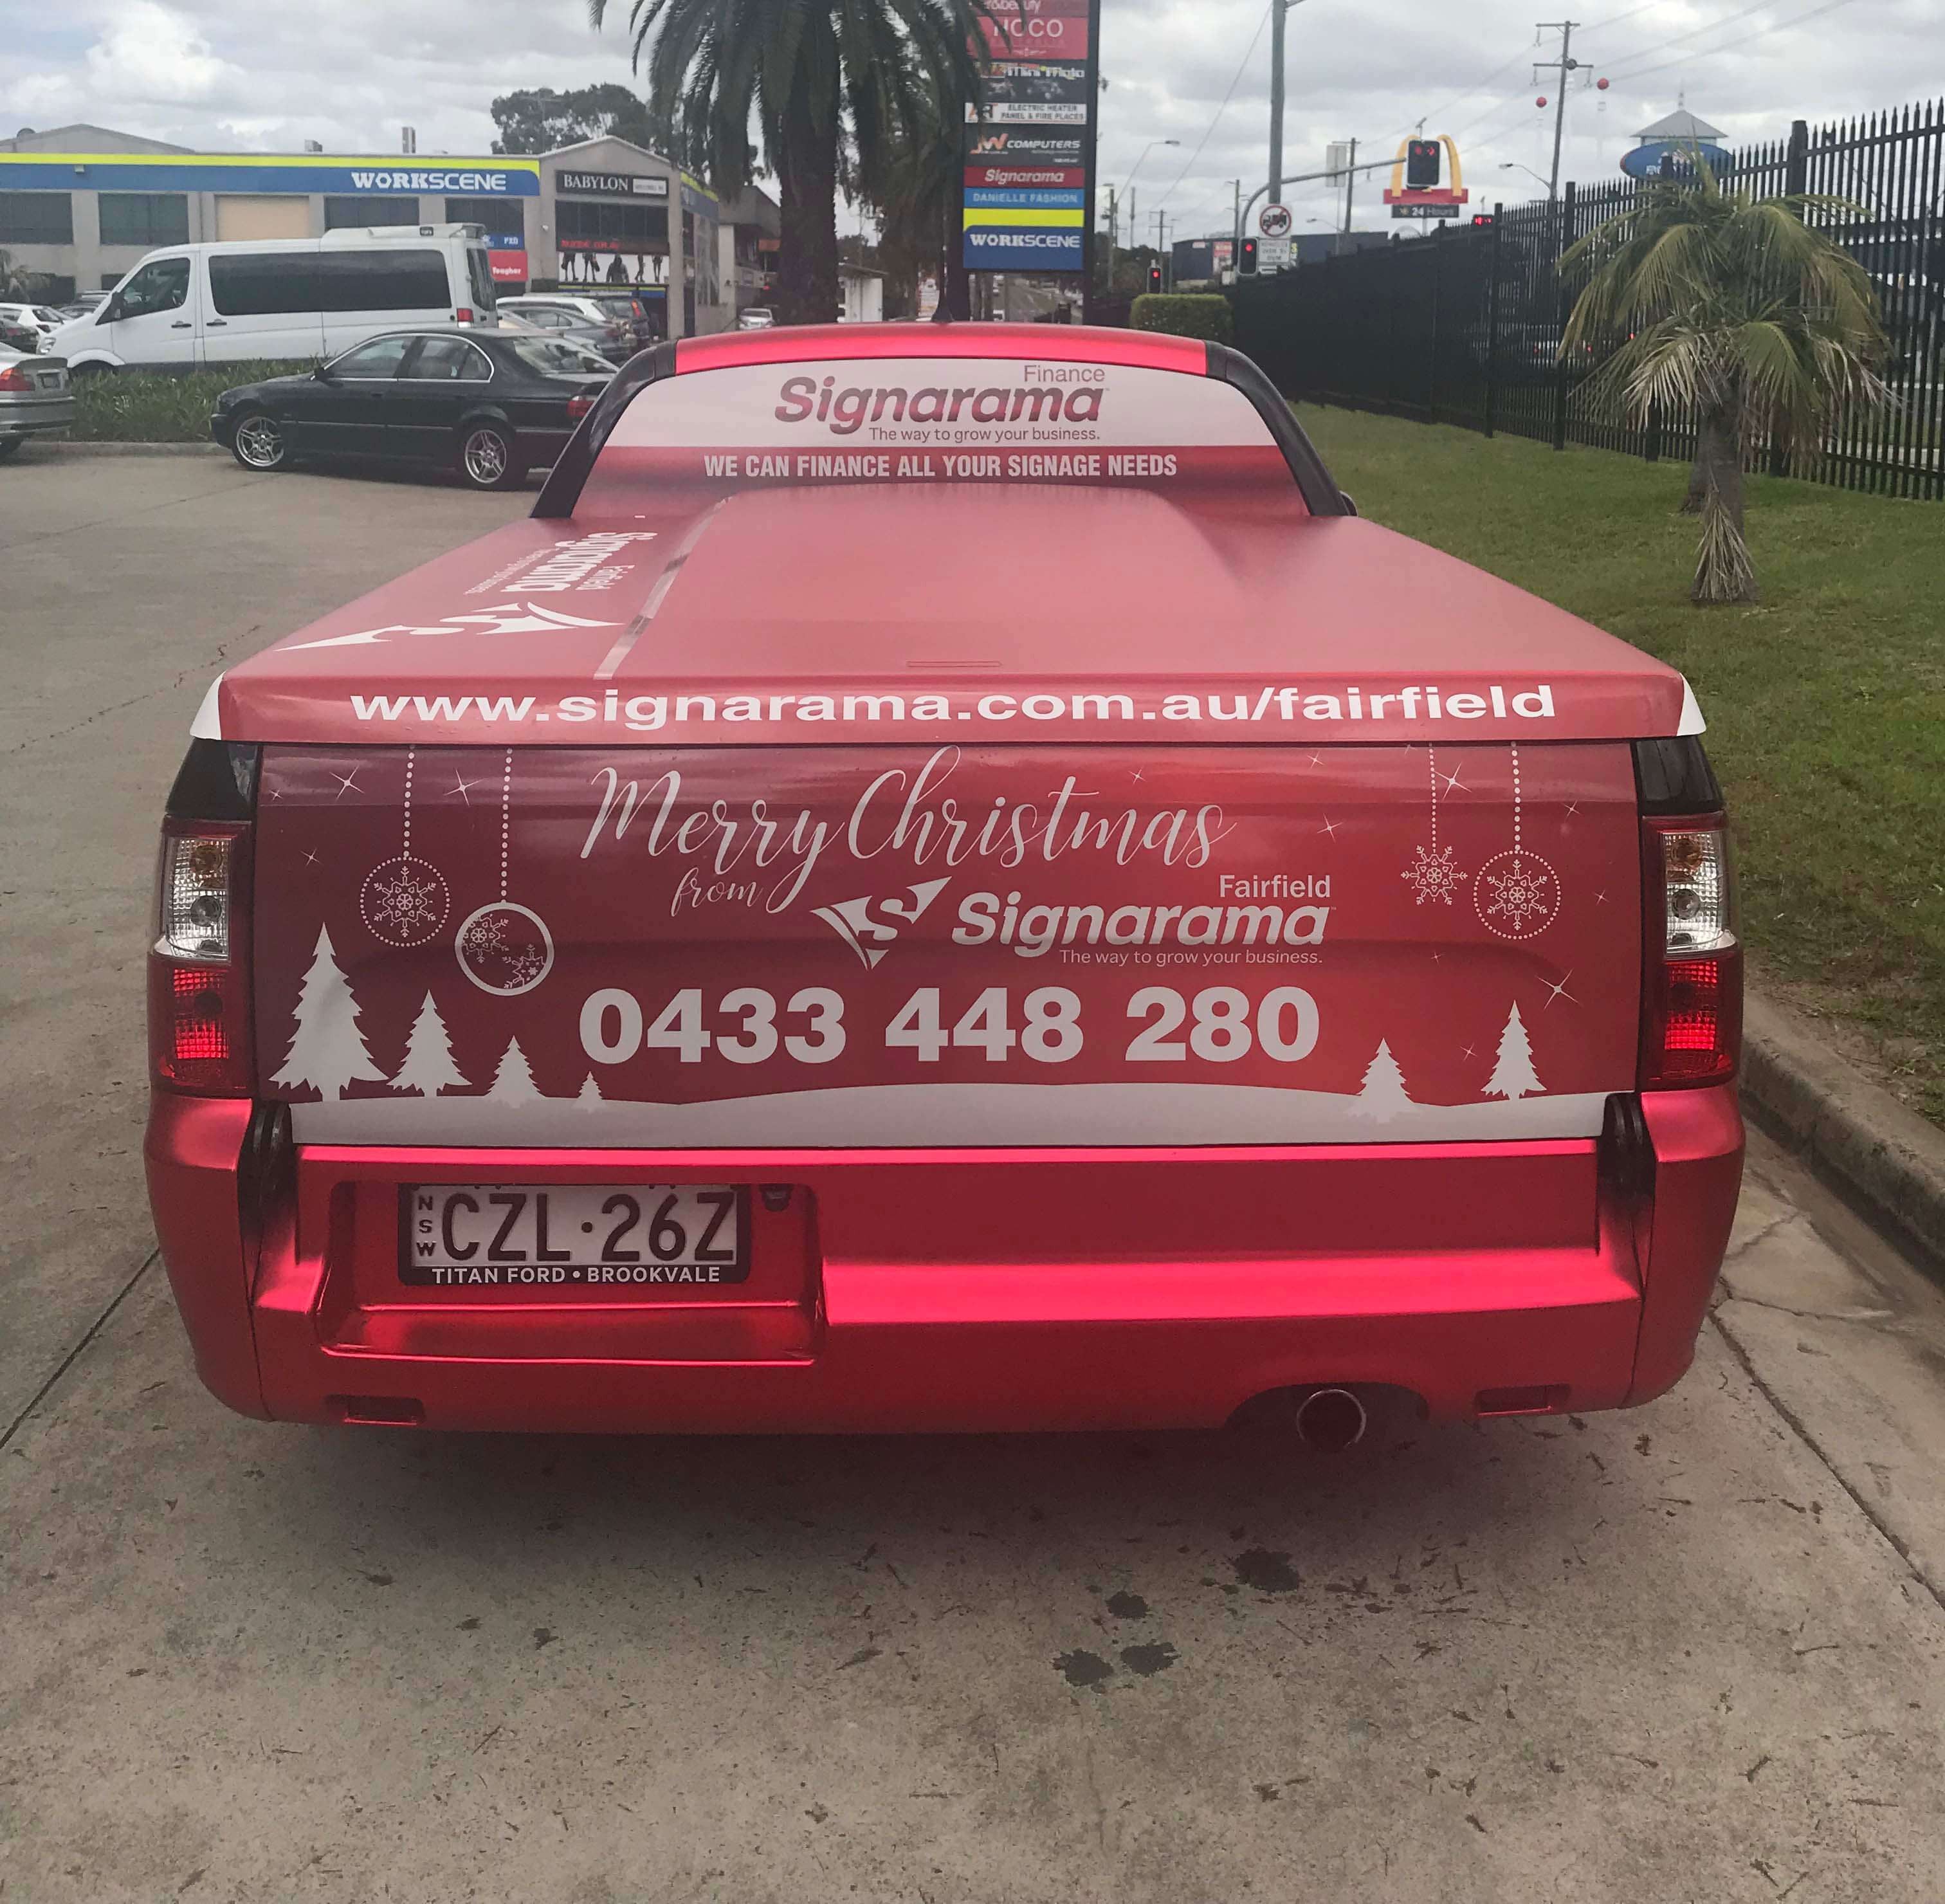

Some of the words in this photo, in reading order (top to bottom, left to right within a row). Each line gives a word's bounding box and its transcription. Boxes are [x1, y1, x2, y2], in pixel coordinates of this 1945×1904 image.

[1007, 140, 1081, 149] COMPUTERS
[351, 172, 506, 191] WORKSCENE
[563, 174, 628, 191] BABYLON
[985, 169, 1064, 185] Signarama
[973, 193, 1026, 203] DANIELLE
[1029, 194, 1077, 203] FASHION
[1411, 206, 1424, 216] 24
[970, 233, 1081, 248] WORKSCENE
[1024, 364, 1105, 383] Finance
[774, 376, 1105, 435] Signarama
[869, 427, 897, 441] The
[901, 430, 929, 443] way
[935, 428, 950, 441] to
[954, 430, 991, 443] grow
[995, 430, 1028, 443] your
[1032, 426, 1100, 441] business.
[704, 455, 738, 477] WE
[745, 455, 790, 477] CAN
[797, 455, 890, 477] FINANCE
[897, 455, 936, 477] ALL
[942, 455, 1001, 477] YOUR
[1008, 454, 1100, 477] SIGNAGE
[1108, 454, 1177, 476] NEEDS
[350, 685, 1557, 731] www.signarama.com.au/fairfield
[580, 766, 844, 913] Merry
[847, 744, 1236, 868] Christmas
[671, 866, 764, 918] from
[1219, 874, 1331, 898] Fairfield
[951, 891, 1330, 958] Signarama
[1060, 949, 1091, 964] The
[1095, 953, 1129, 967] way
[1134, 951, 1151, 964] to
[1156, 953, 1199, 967] grow
[1203, 953, 1241, 967] your
[1246, 949, 1323, 964] business.
[580, 987, 846, 1065] 0433
[885, 986, 1084, 1064] 448
[1125, 985, 1320, 1063] 280
[432, 1268, 498, 1284] TITAN
[507, 1267, 565, 1283] FORD
[587, 1266, 720, 1283] BROOKVALE
